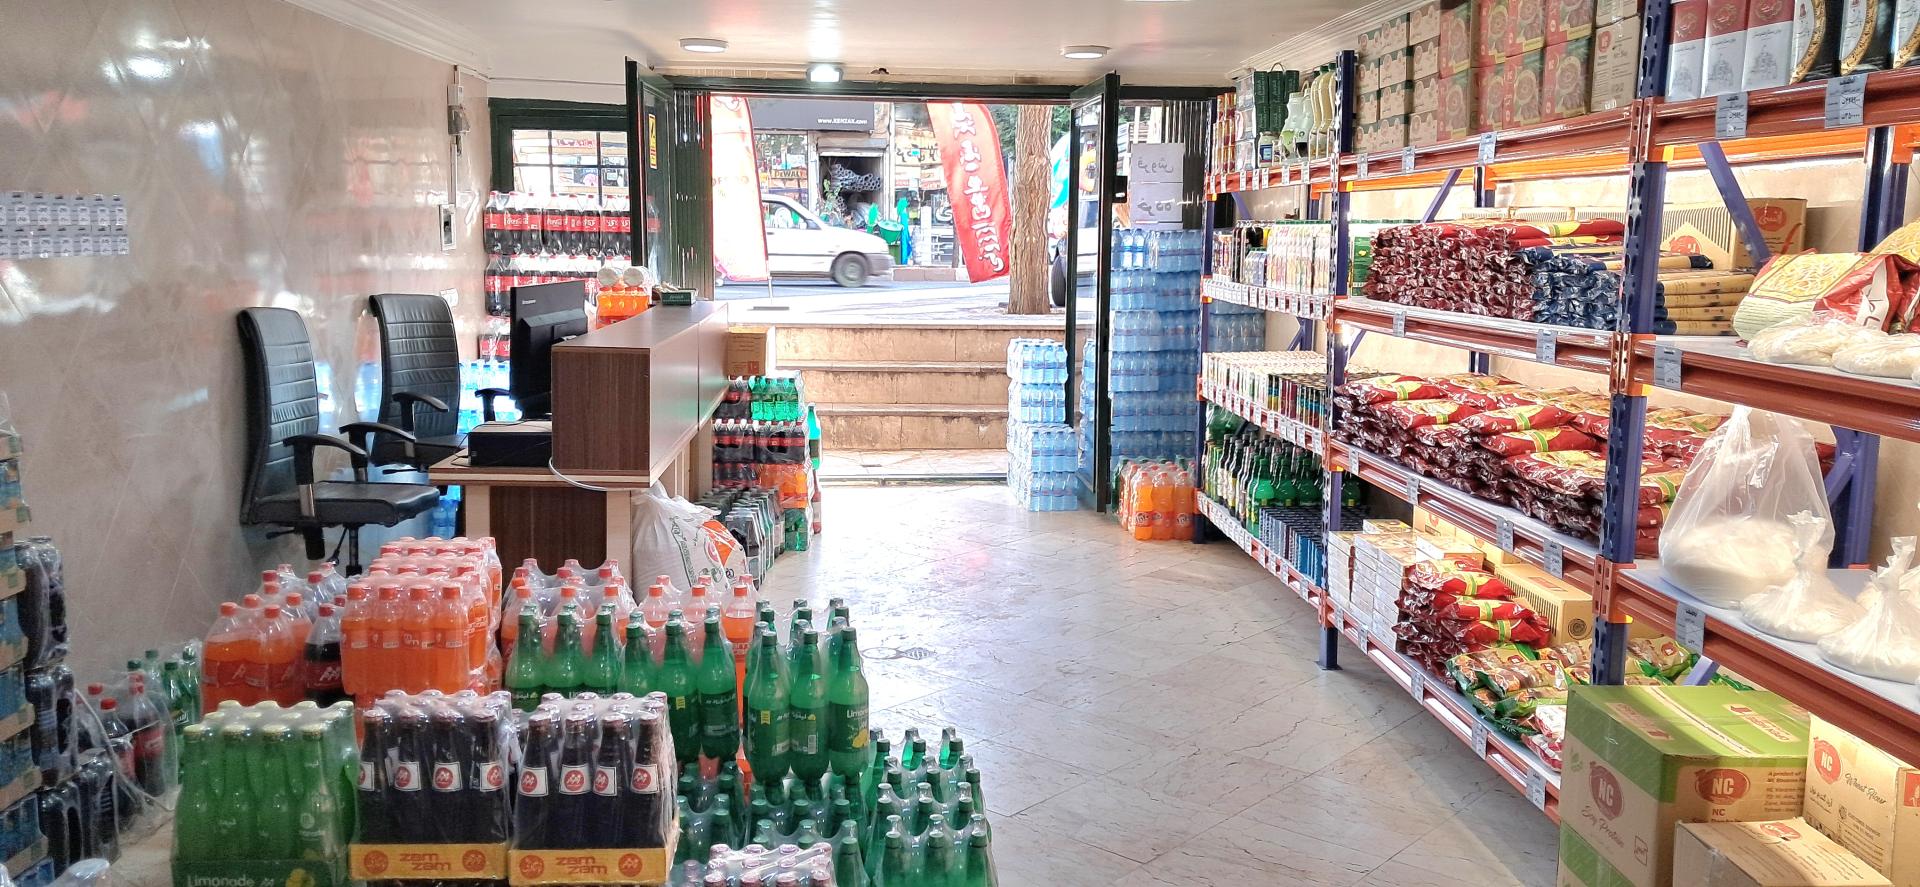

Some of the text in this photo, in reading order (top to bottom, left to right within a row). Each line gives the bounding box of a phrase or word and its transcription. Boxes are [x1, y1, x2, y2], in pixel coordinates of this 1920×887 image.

[1821, 751, 1833, 772] NC
[1712, 777, 1735, 795] NC
[1598, 778, 1614, 807] NC
[1712, 808, 1726, 817] NC
[399, 851, 439, 863] zam
[555, 854, 596, 866] zam
[411, 860, 451, 871] zam
[567, 864, 607, 875] zam
[186, 874, 256, 887] Limonade
